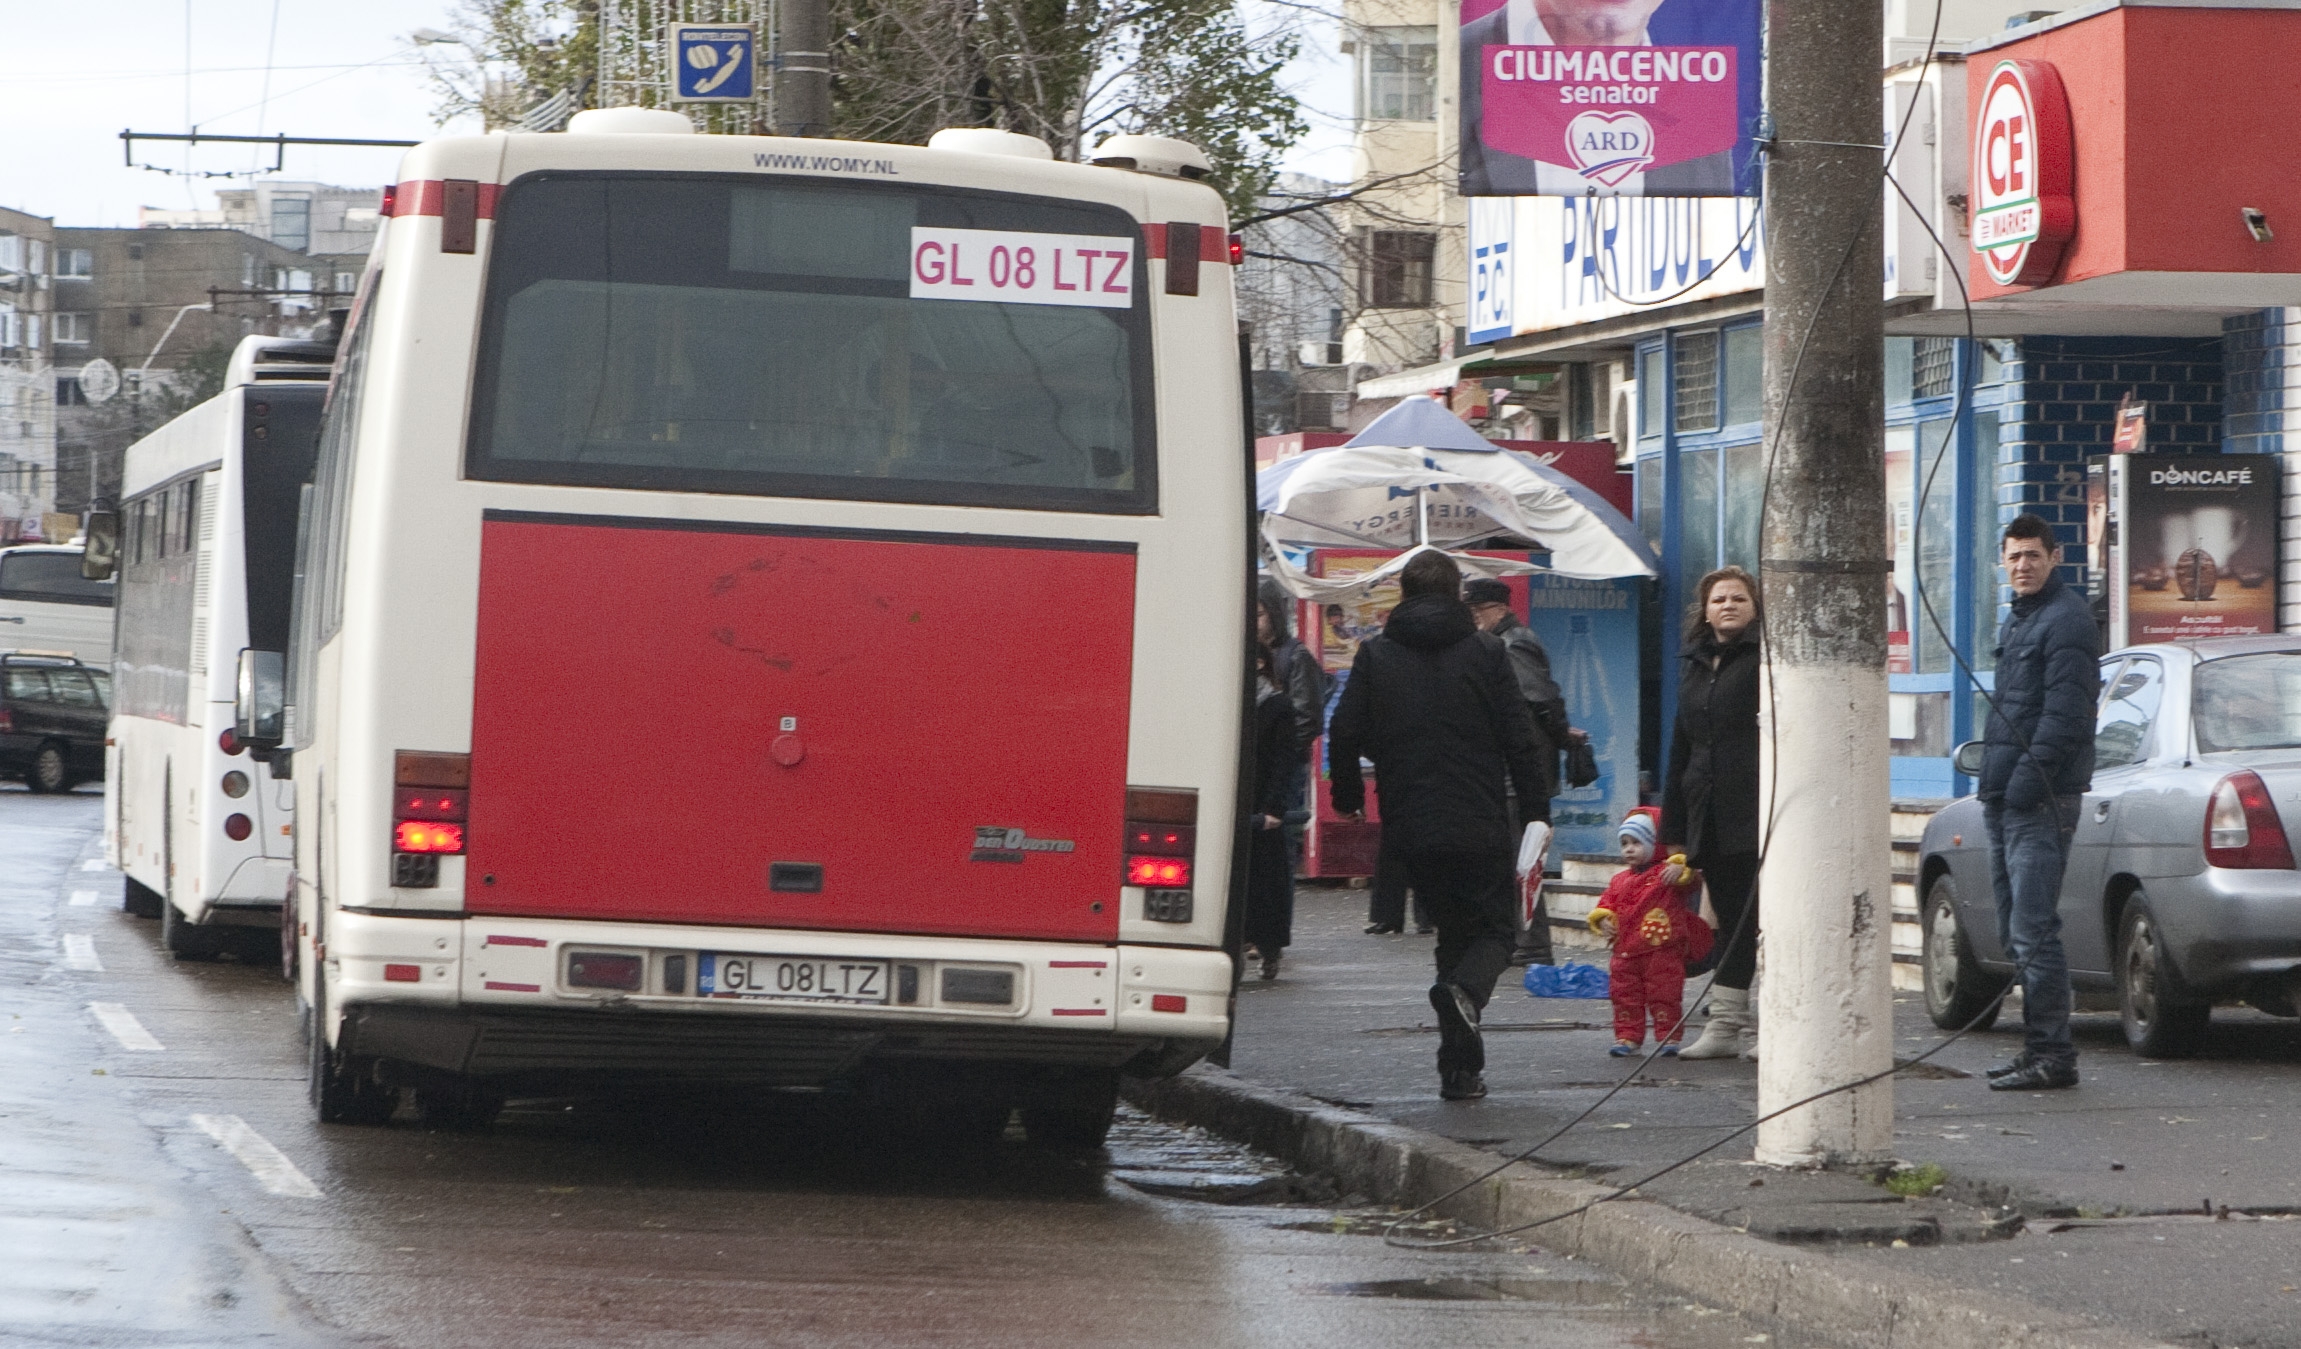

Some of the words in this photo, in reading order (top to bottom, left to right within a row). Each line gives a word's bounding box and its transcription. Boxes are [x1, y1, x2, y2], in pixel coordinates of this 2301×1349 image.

[1493, 50, 1728, 83] CIUMACENCO
[1560, 83, 1660, 104] senator
[1581, 131, 1640, 151] ARD
[1987, 115, 2024, 197] CE
[754, 153, 899, 175] WWW.WOMY.NL
[1993, 208, 2034, 238] MARKET
[915, 240, 974, 286] GL
[989, 245, 1036, 290] 08
[1052, 248, 1129, 294] LTZ
[2150, 466, 2253, 485] DONCAFÉ
[723, 960, 763, 990] GL
